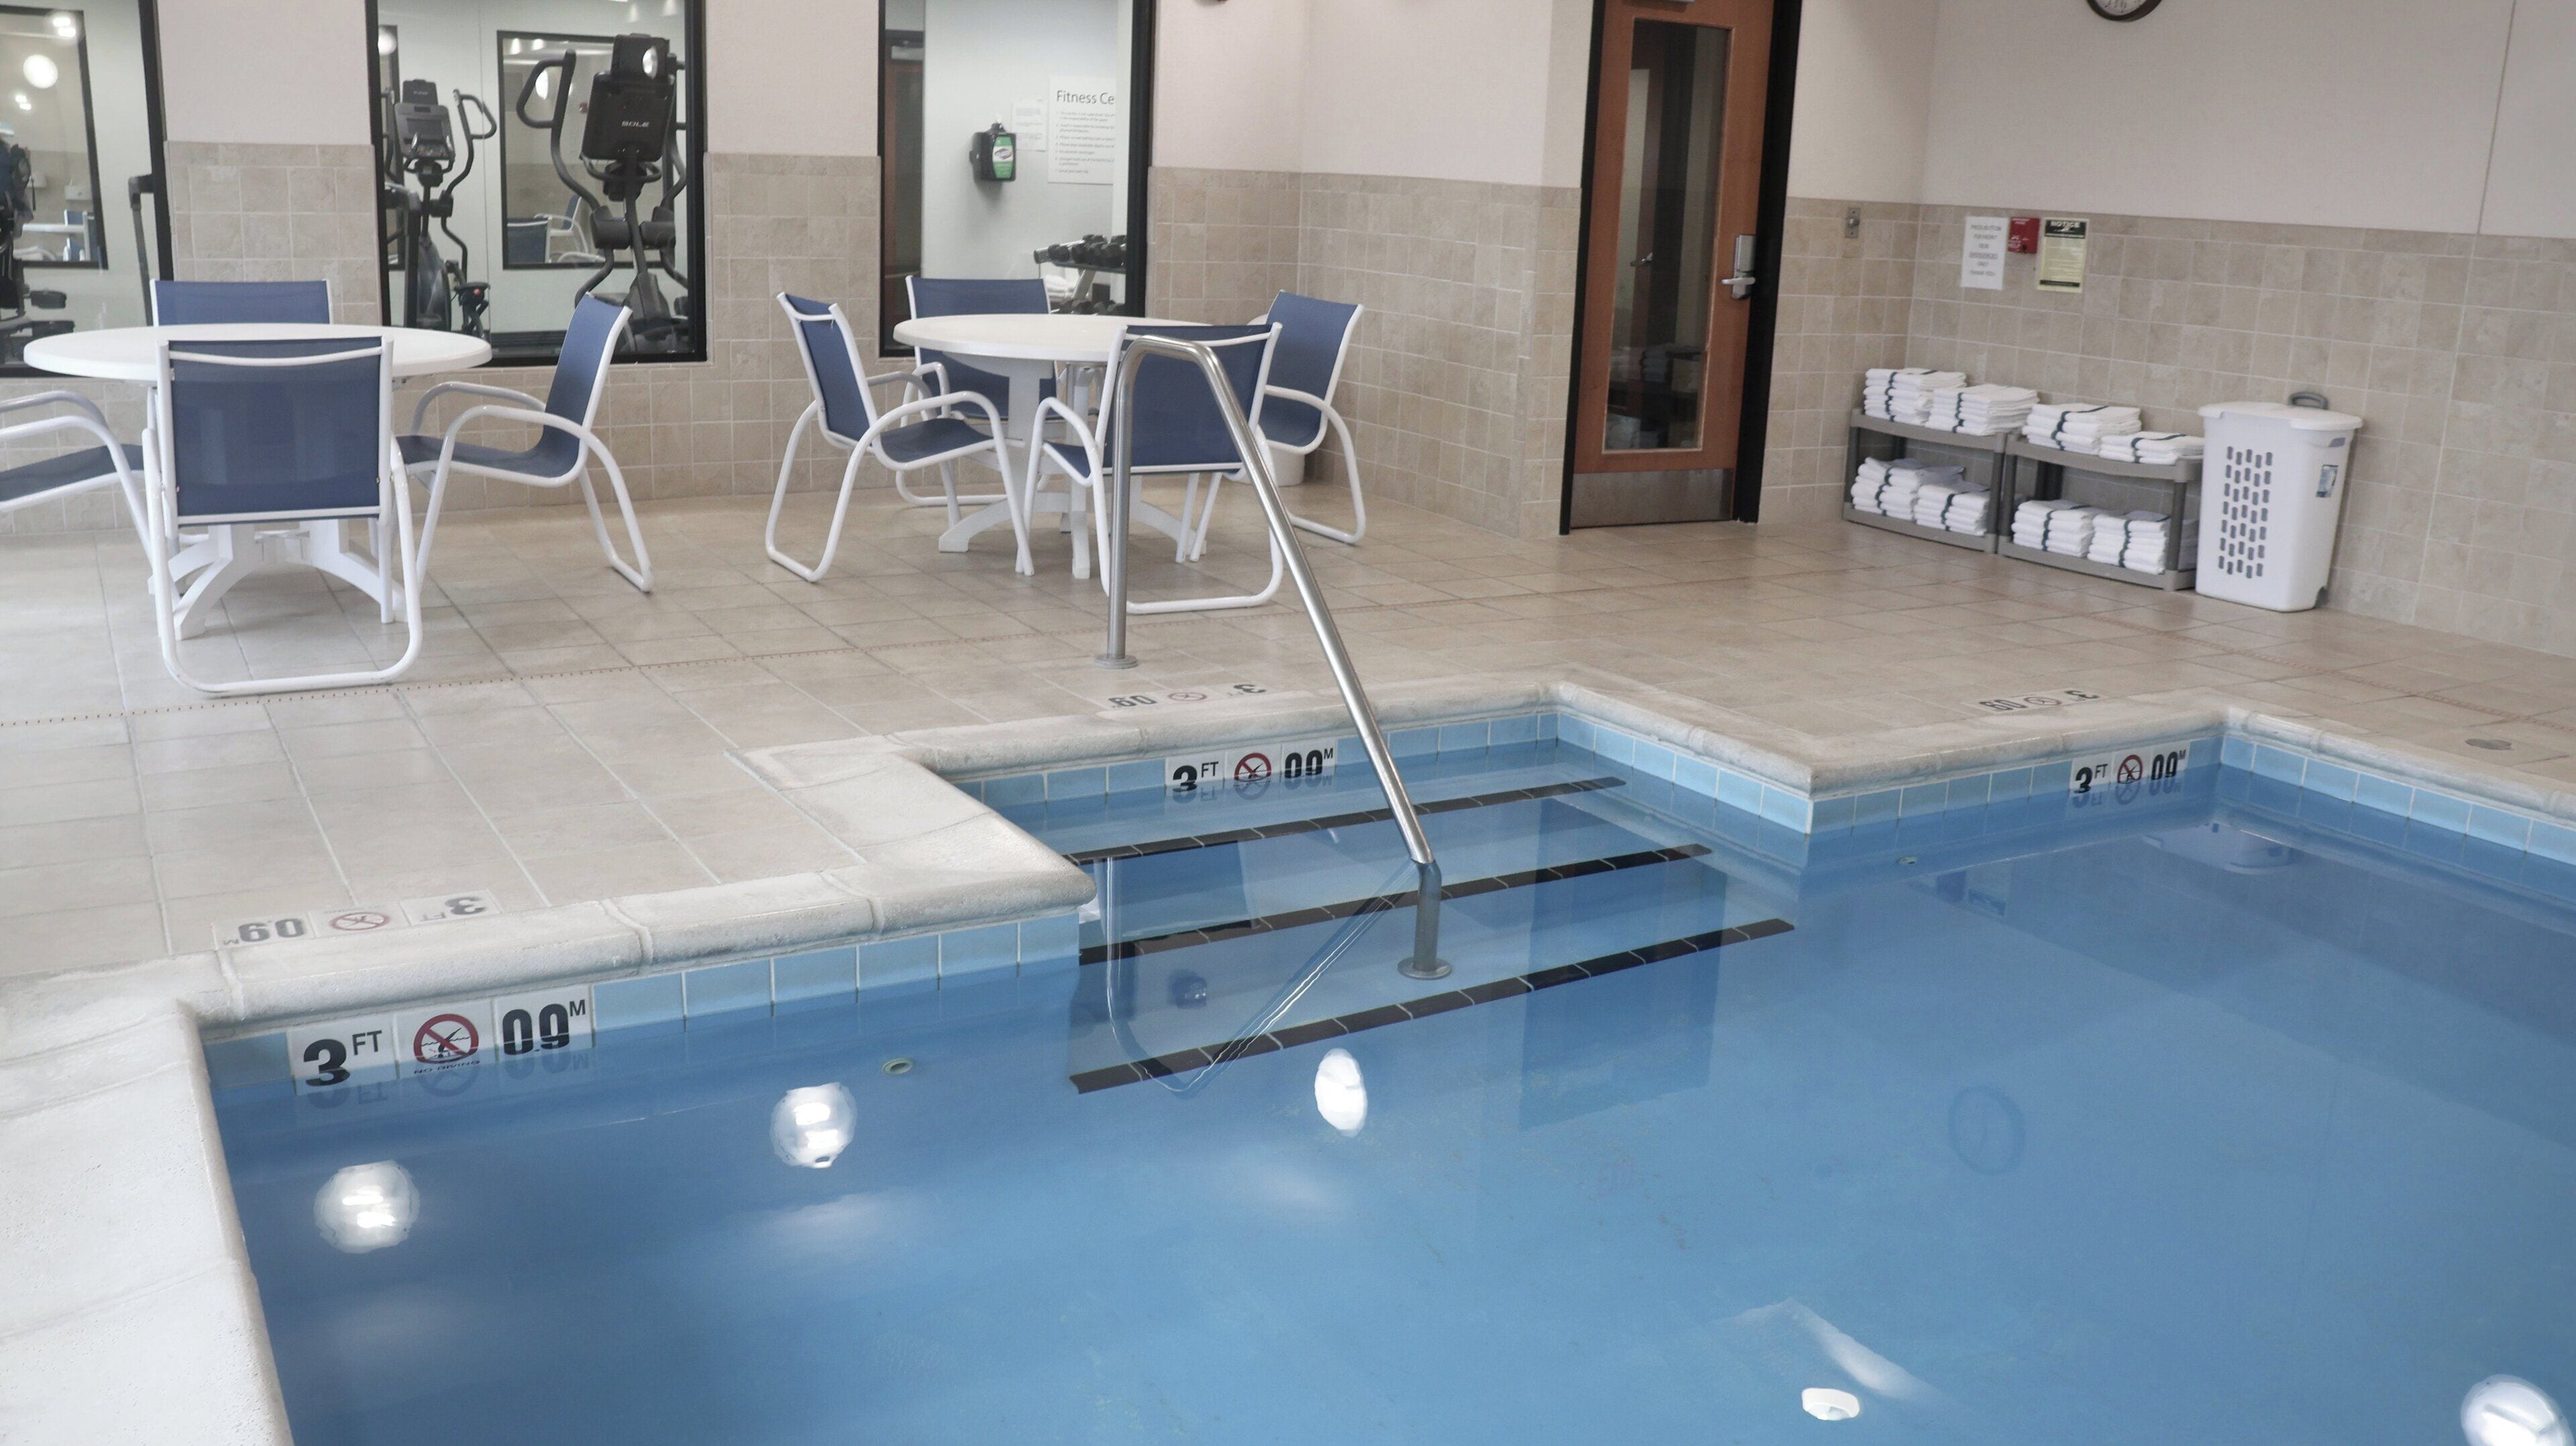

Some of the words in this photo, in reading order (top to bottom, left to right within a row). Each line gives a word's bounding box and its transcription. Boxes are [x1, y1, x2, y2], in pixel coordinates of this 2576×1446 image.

[1057, 89, 1097, 104] Fitness
[1233, 684, 1267, 694] 3
[1172, 765, 1197, 792] 3
[1201, 761, 1220, 778] FT
[2074, 766, 2093, 794] 3
[2094, 764, 2108, 779] FT
[444, 896, 488, 915] 3
[419, 911, 447, 923] FT
[569, 998, 586, 1017] M
[303, 1039, 350, 1086] 3
[352, 1029, 382, 1055] FT
[437, 1060, 481, 1070] DIVING
